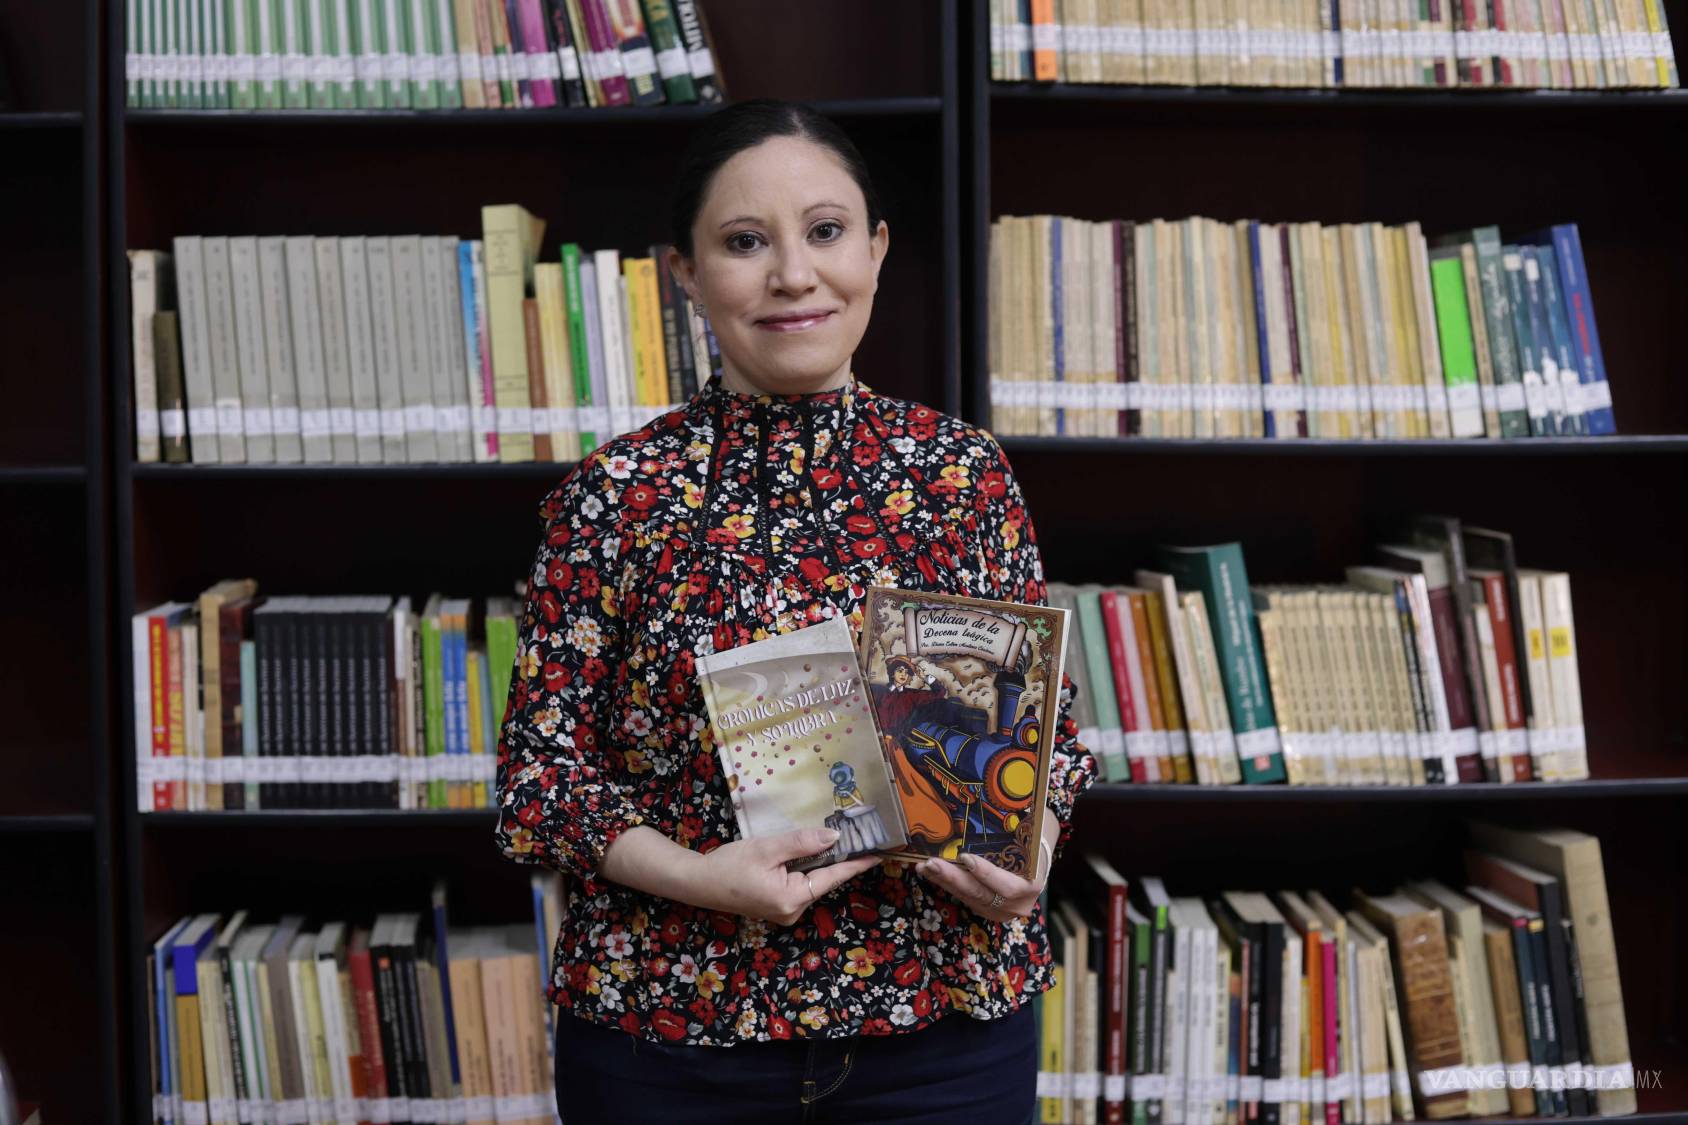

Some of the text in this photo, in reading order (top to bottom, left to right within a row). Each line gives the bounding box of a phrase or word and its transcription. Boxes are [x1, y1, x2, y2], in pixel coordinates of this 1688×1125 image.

[920, 611, 1000, 635] Noticias de la
[717, 679, 856, 730] CRONICAS DE LUZ
[746, 709, 838, 747] Y SOMBRA
